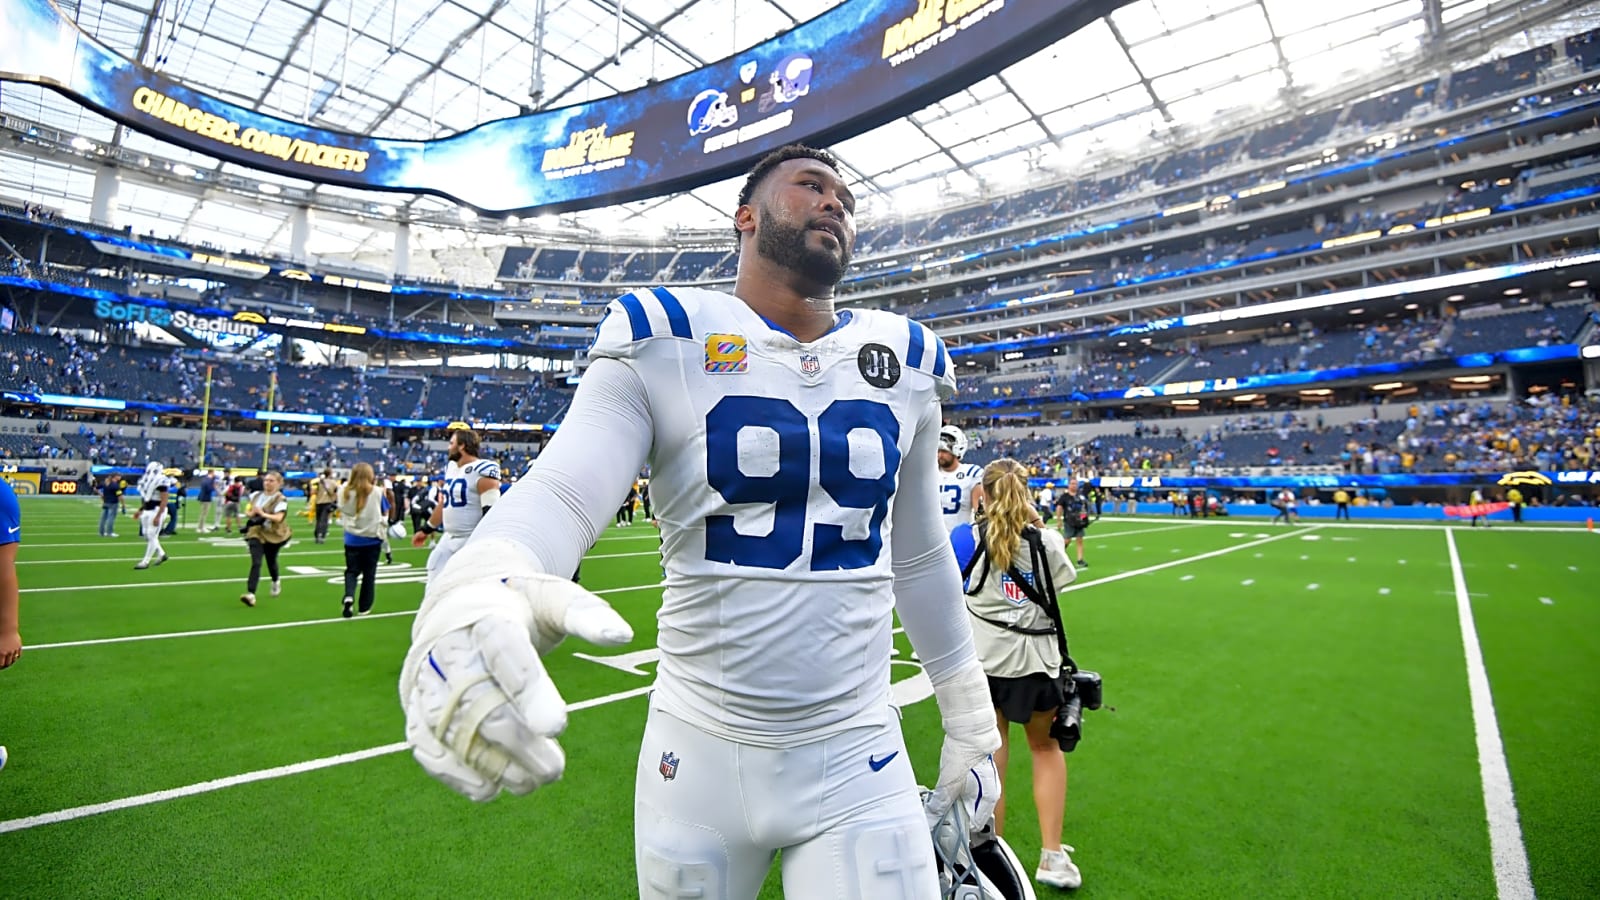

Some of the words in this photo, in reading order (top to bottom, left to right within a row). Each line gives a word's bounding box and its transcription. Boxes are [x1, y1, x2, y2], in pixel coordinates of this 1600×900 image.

[132, 86, 369, 172] CHARGERS.COM/TICKETS
[94, 301, 146, 322] SoFi
[173, 310, 259, 336] Stadium
[51, 481, 77, 493] 0:00
[705, 395, 901, 571] 99
